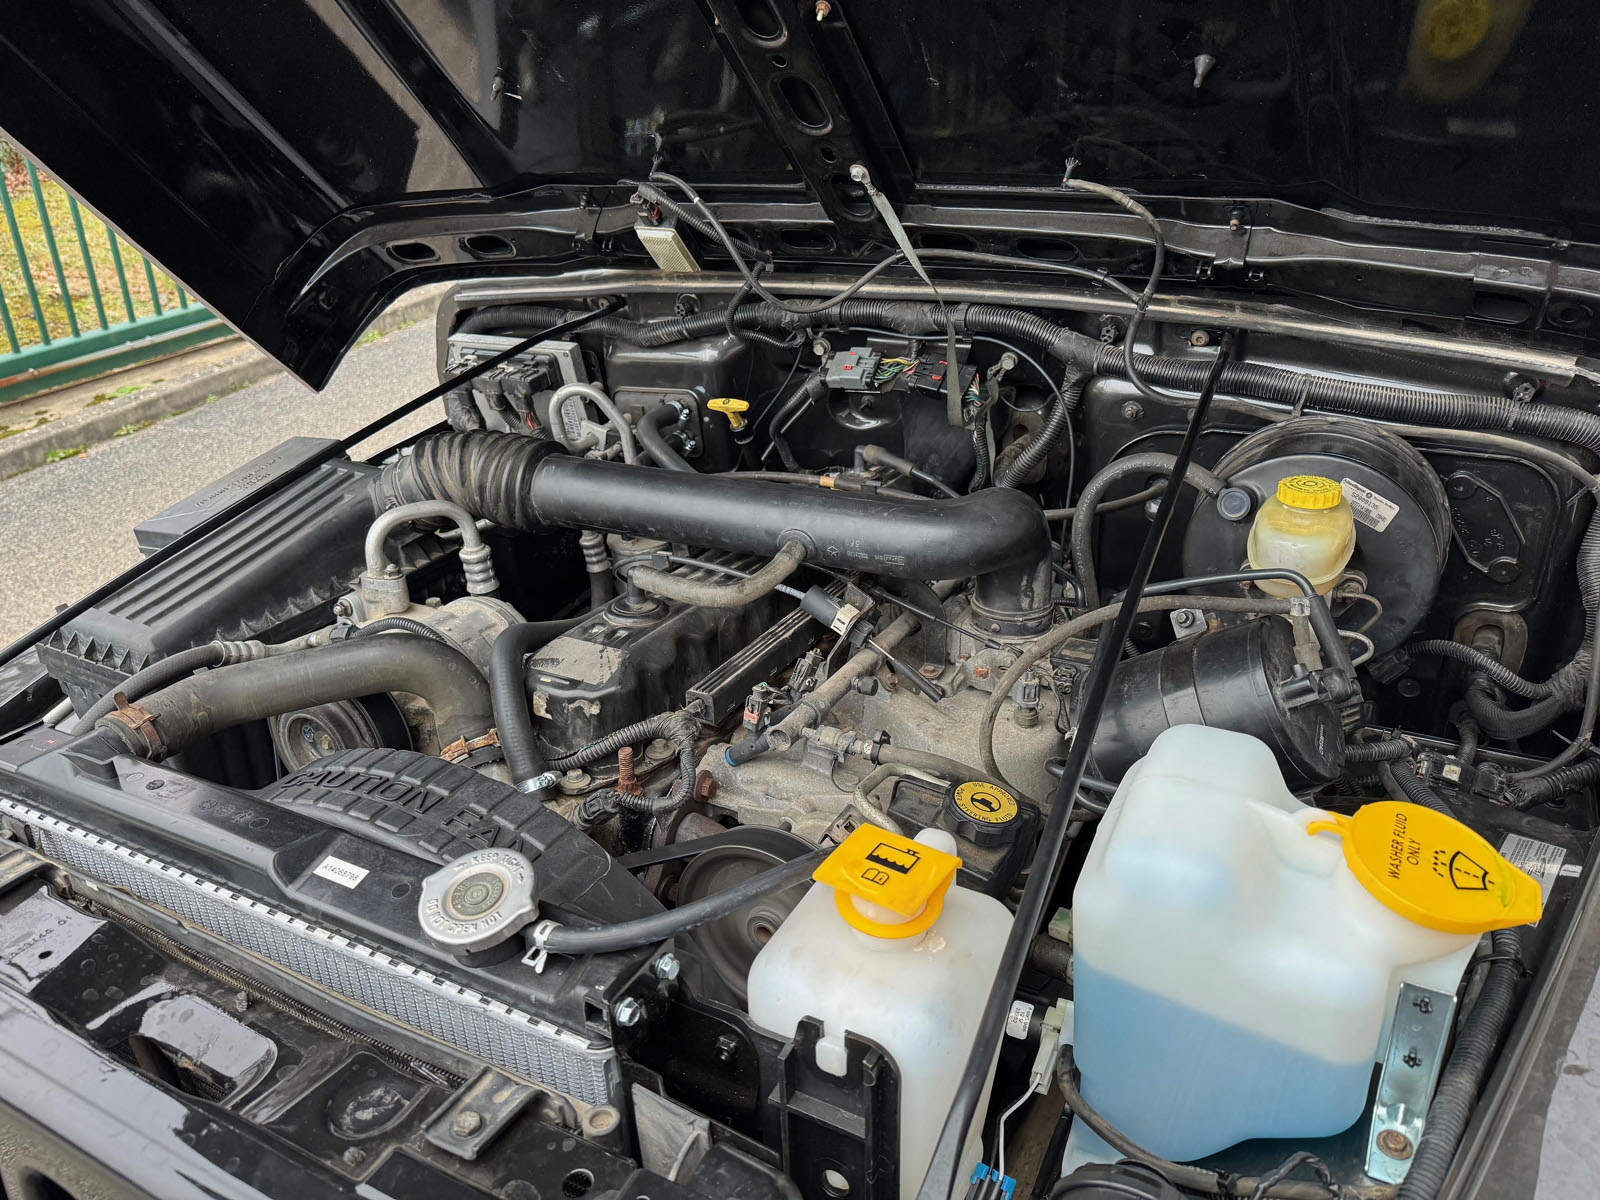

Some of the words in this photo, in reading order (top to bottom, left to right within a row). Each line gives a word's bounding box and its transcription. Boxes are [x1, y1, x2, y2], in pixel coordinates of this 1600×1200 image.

[280, 770, 444, 814] CAUTION
[989, 786, 1016, 806] APPROVED
[960, 803, 992, 821] STEERING
[1392, 813, 1408, 839] FLUID
[1388, 838, 1405, 880] WASHER
[1407, 838, 1421, 866] ONLY
[472, 853, 499, 864] KEEP
[500, 854, 525, 873] TIGHT
[427, 898, 439, 911] DO
[430, 911, 450, 928] NOT
[448, 922, 478, 934] OPEN
[481, 911, 503, 928] HOT
